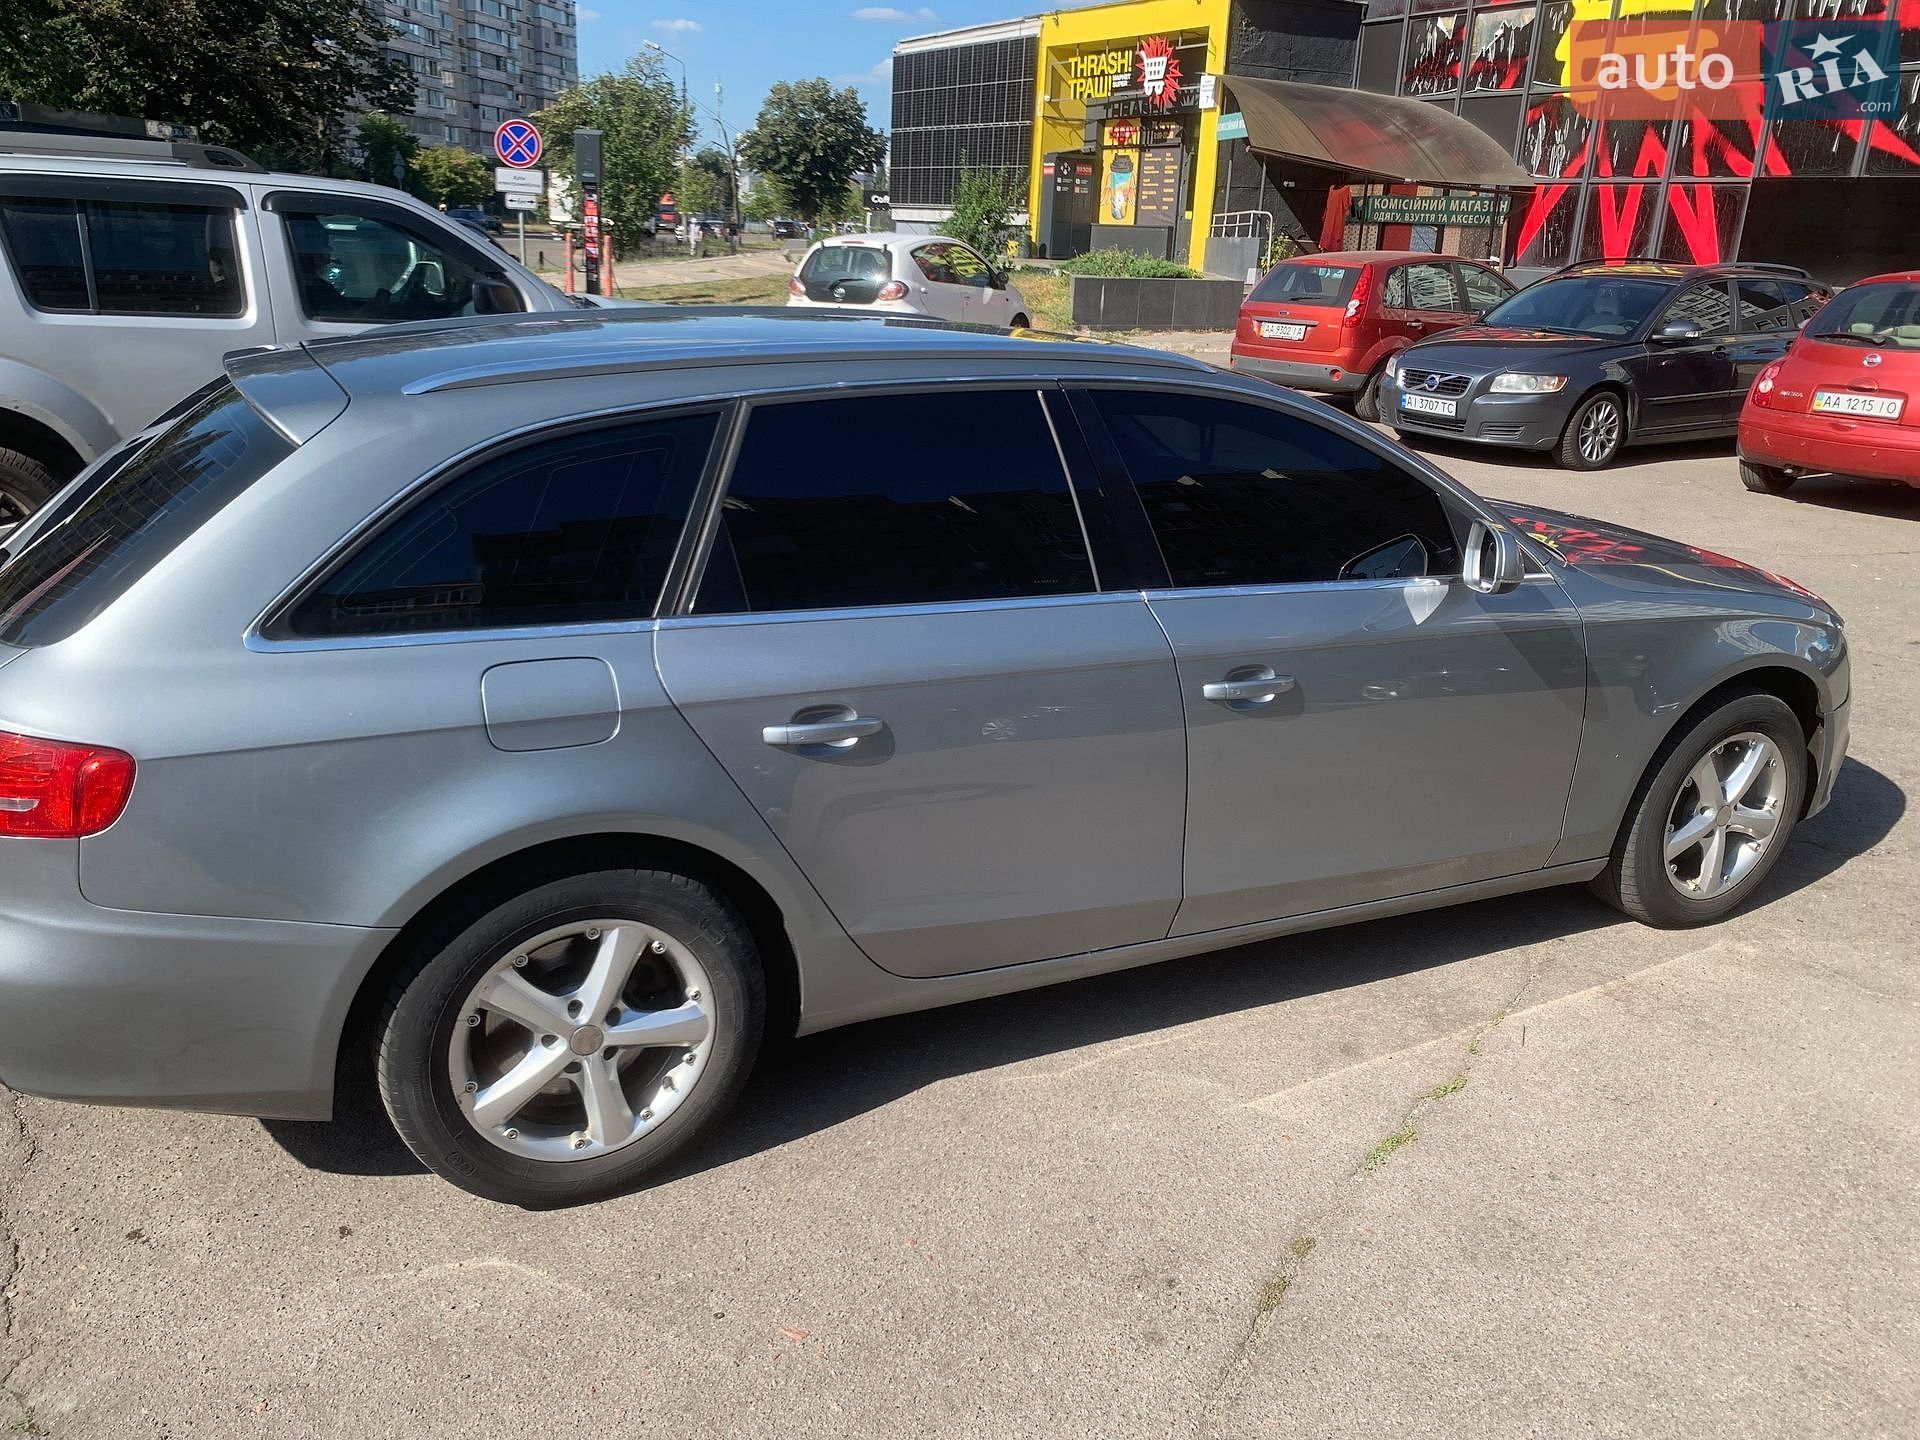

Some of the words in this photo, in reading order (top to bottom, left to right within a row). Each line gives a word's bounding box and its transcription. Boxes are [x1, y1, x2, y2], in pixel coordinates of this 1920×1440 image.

[1068, 50, 1133, 78] THRASH!
[1068, 75, 1112, 100] ТРАШ!
[1374, 197, 1446, 211] КОМІСІЙНИЙ
[1373, 211, 1402, 222] ОДЯГУ,
[1404, 213, 1435, 223] ВЗУТТЯ
[1438, 213, 1448, 223] ТА
[1450, 214, 1505, 225] АКСЕСУАІВ
[1407, 396, 1417, 408] AI
[1419, 398, 1439, 411] 3707
[1441, 401, 1454, 414] TC
[1823, 396, 1841, 410] AA
[1846, 398, 1875, 412] 1215
[1879, 401, 1897, 414] IO
